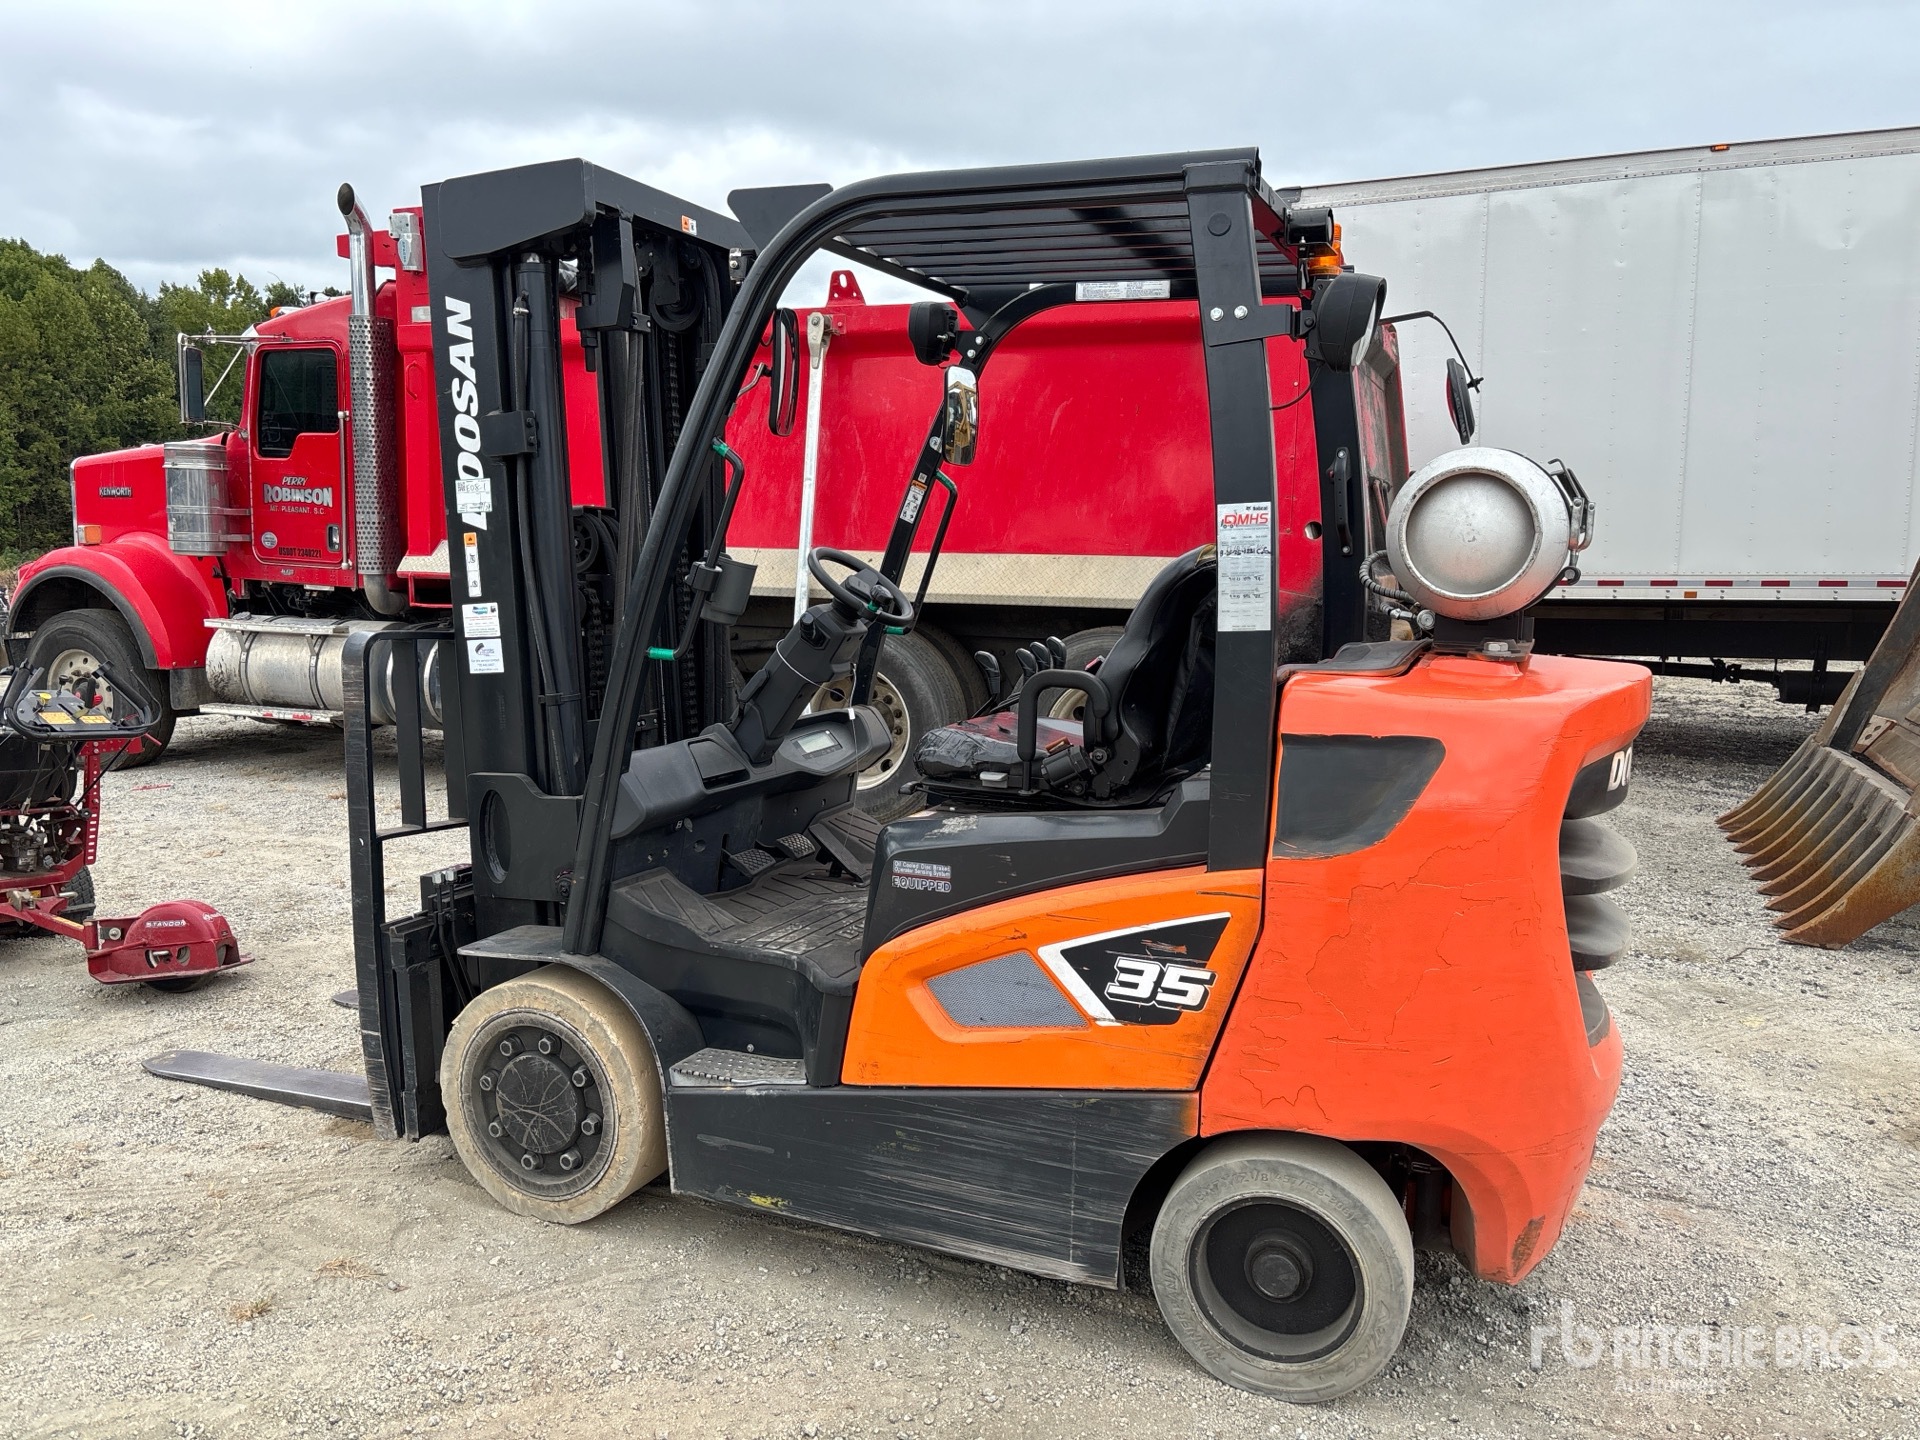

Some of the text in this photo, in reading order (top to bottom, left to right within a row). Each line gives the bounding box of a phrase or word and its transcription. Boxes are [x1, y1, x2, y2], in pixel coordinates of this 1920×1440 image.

[282, 476, 308, 486] PERRY
[99, 486, 132, 497] KENWORTH
[263, 483, 333, 508] ROBINSON
[279, 547, 297, 556] USDOT
[903, 861, 919, 869] Cooled
[892, 876, 951, 892] EQUIPPED
[1104, 956, 1218, 1013] 35
